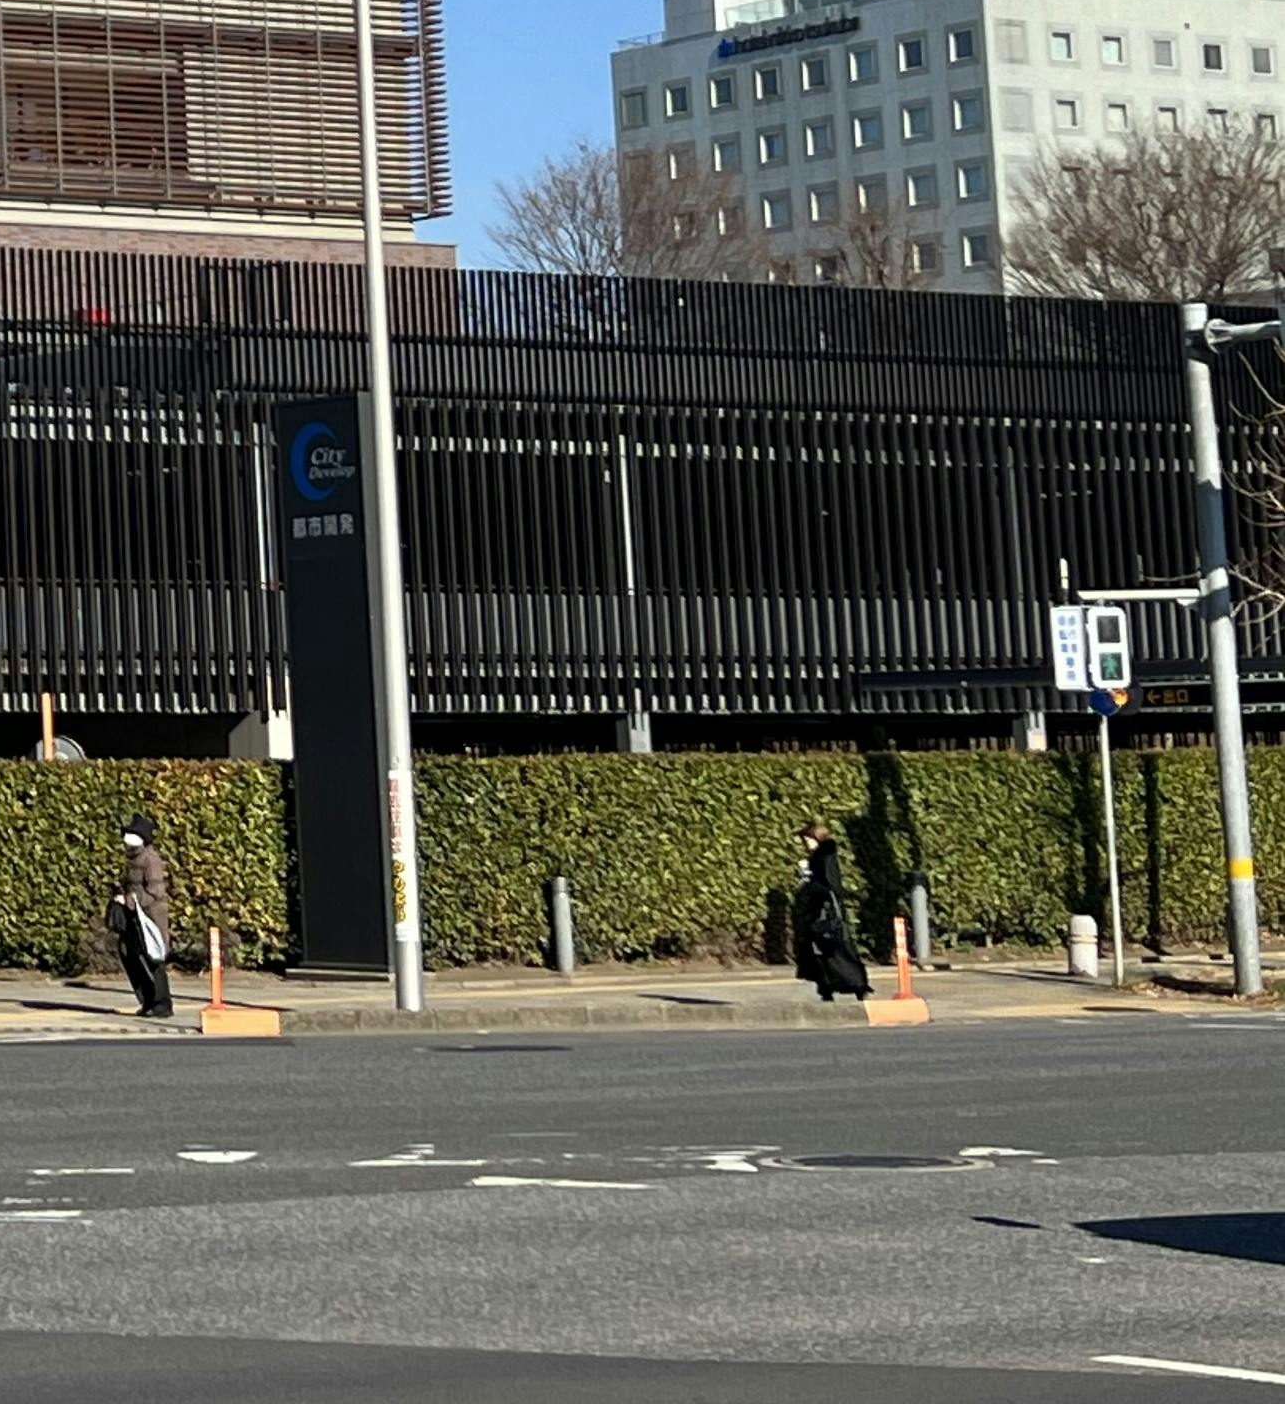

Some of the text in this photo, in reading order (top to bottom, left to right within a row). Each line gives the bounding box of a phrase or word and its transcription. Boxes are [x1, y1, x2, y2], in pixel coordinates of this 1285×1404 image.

[311, 447, 347, 468] City
[293, 513, 354, 539] 都市開発
